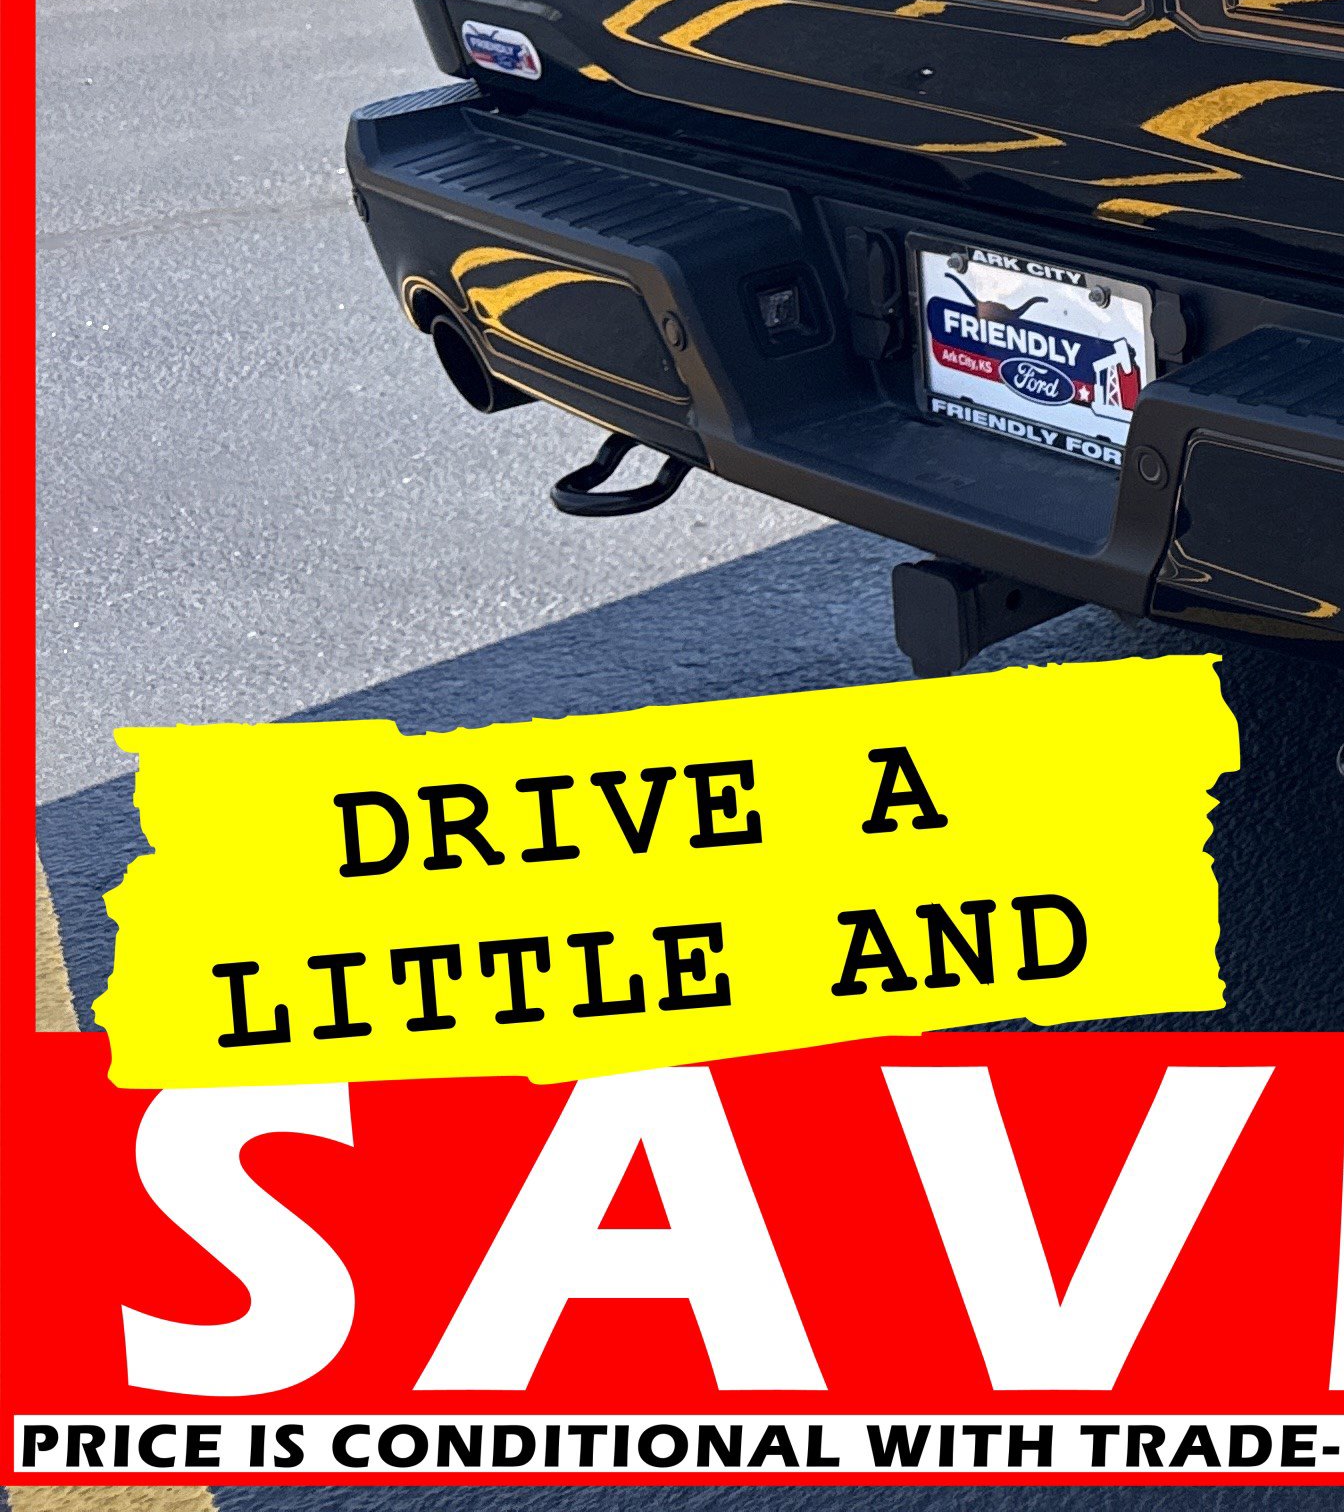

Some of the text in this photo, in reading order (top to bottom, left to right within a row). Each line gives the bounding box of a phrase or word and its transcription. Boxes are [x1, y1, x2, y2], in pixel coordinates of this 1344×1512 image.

[971, 249, 1083, 286] ARK CITY
[943, 307, 1083, 367] FRIENDLY
[942, 348, 958, 363] Ark
[977, 358, 993, 374] KS
[1013, 361, 1060, 399] Ford
[931, 398, 1123, 465] FRIENDLY FOR
